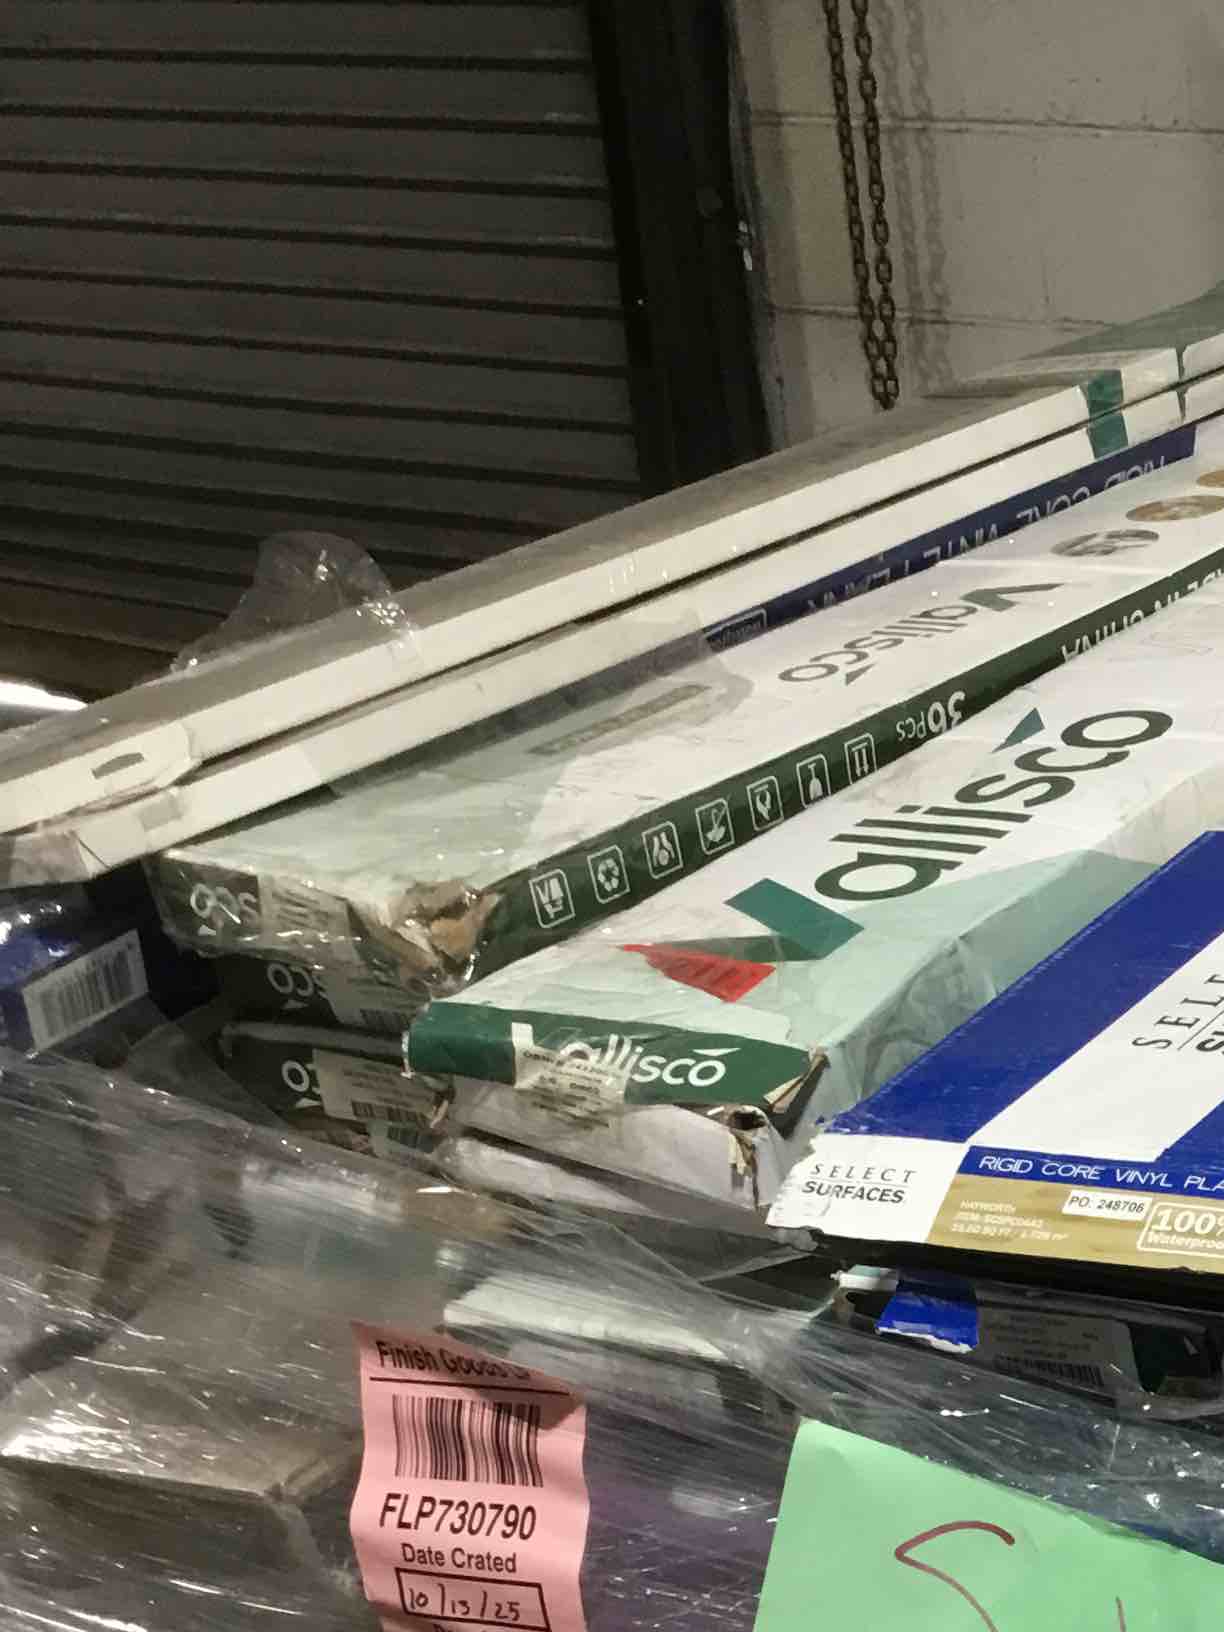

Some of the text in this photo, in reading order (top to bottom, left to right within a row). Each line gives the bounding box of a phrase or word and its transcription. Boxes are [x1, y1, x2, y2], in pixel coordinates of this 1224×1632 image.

[808, 1163, 918, 1184] SELECT
[978, 1154, 1034, 1175] RIGID
[1040, 1158, 1106, 1182] CORE
[1114, 1167, 1174, 1188] VINYL
[801, 1180, 906, 1204] SURFACES
[1096, 1198, 1145, 1214] 248706
[375, 1339, 441, 1372] Finish
[379, 1492, 537, 1541] FLP730790
[400, 1543, 518, 1573] Date Crated
